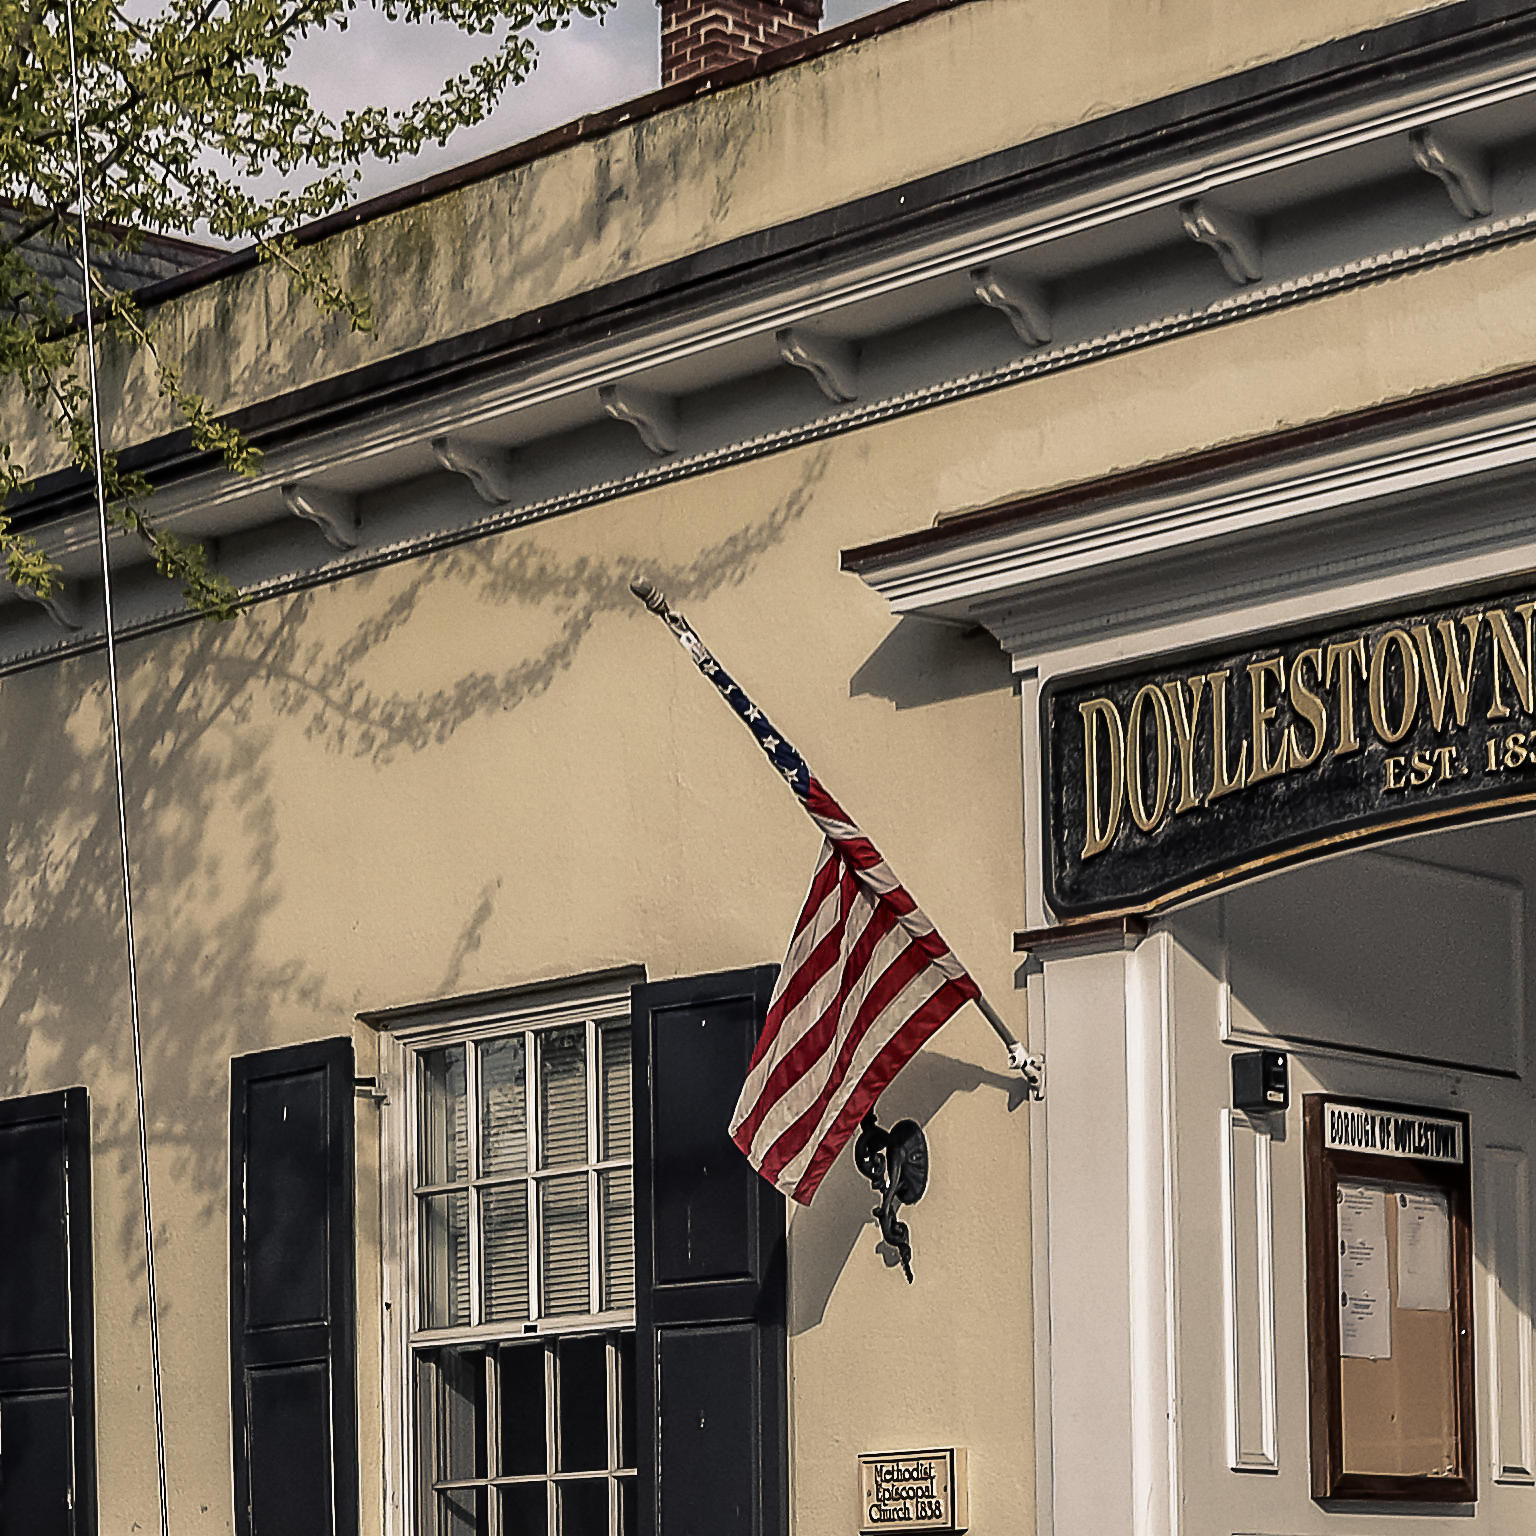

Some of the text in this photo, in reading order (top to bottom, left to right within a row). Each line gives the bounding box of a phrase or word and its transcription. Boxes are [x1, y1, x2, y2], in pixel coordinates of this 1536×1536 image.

[1382, 744, 1464, 796] EST.
[1330, 1109, 1377, 1148] BOROUGH
[1379, 1116, 1392, 1150] OF
[874, 1461, 936, 1482] Methodist
[875, 1479, 937, 1506] Episcopal
[868, 1501, 912, 1523] Church
